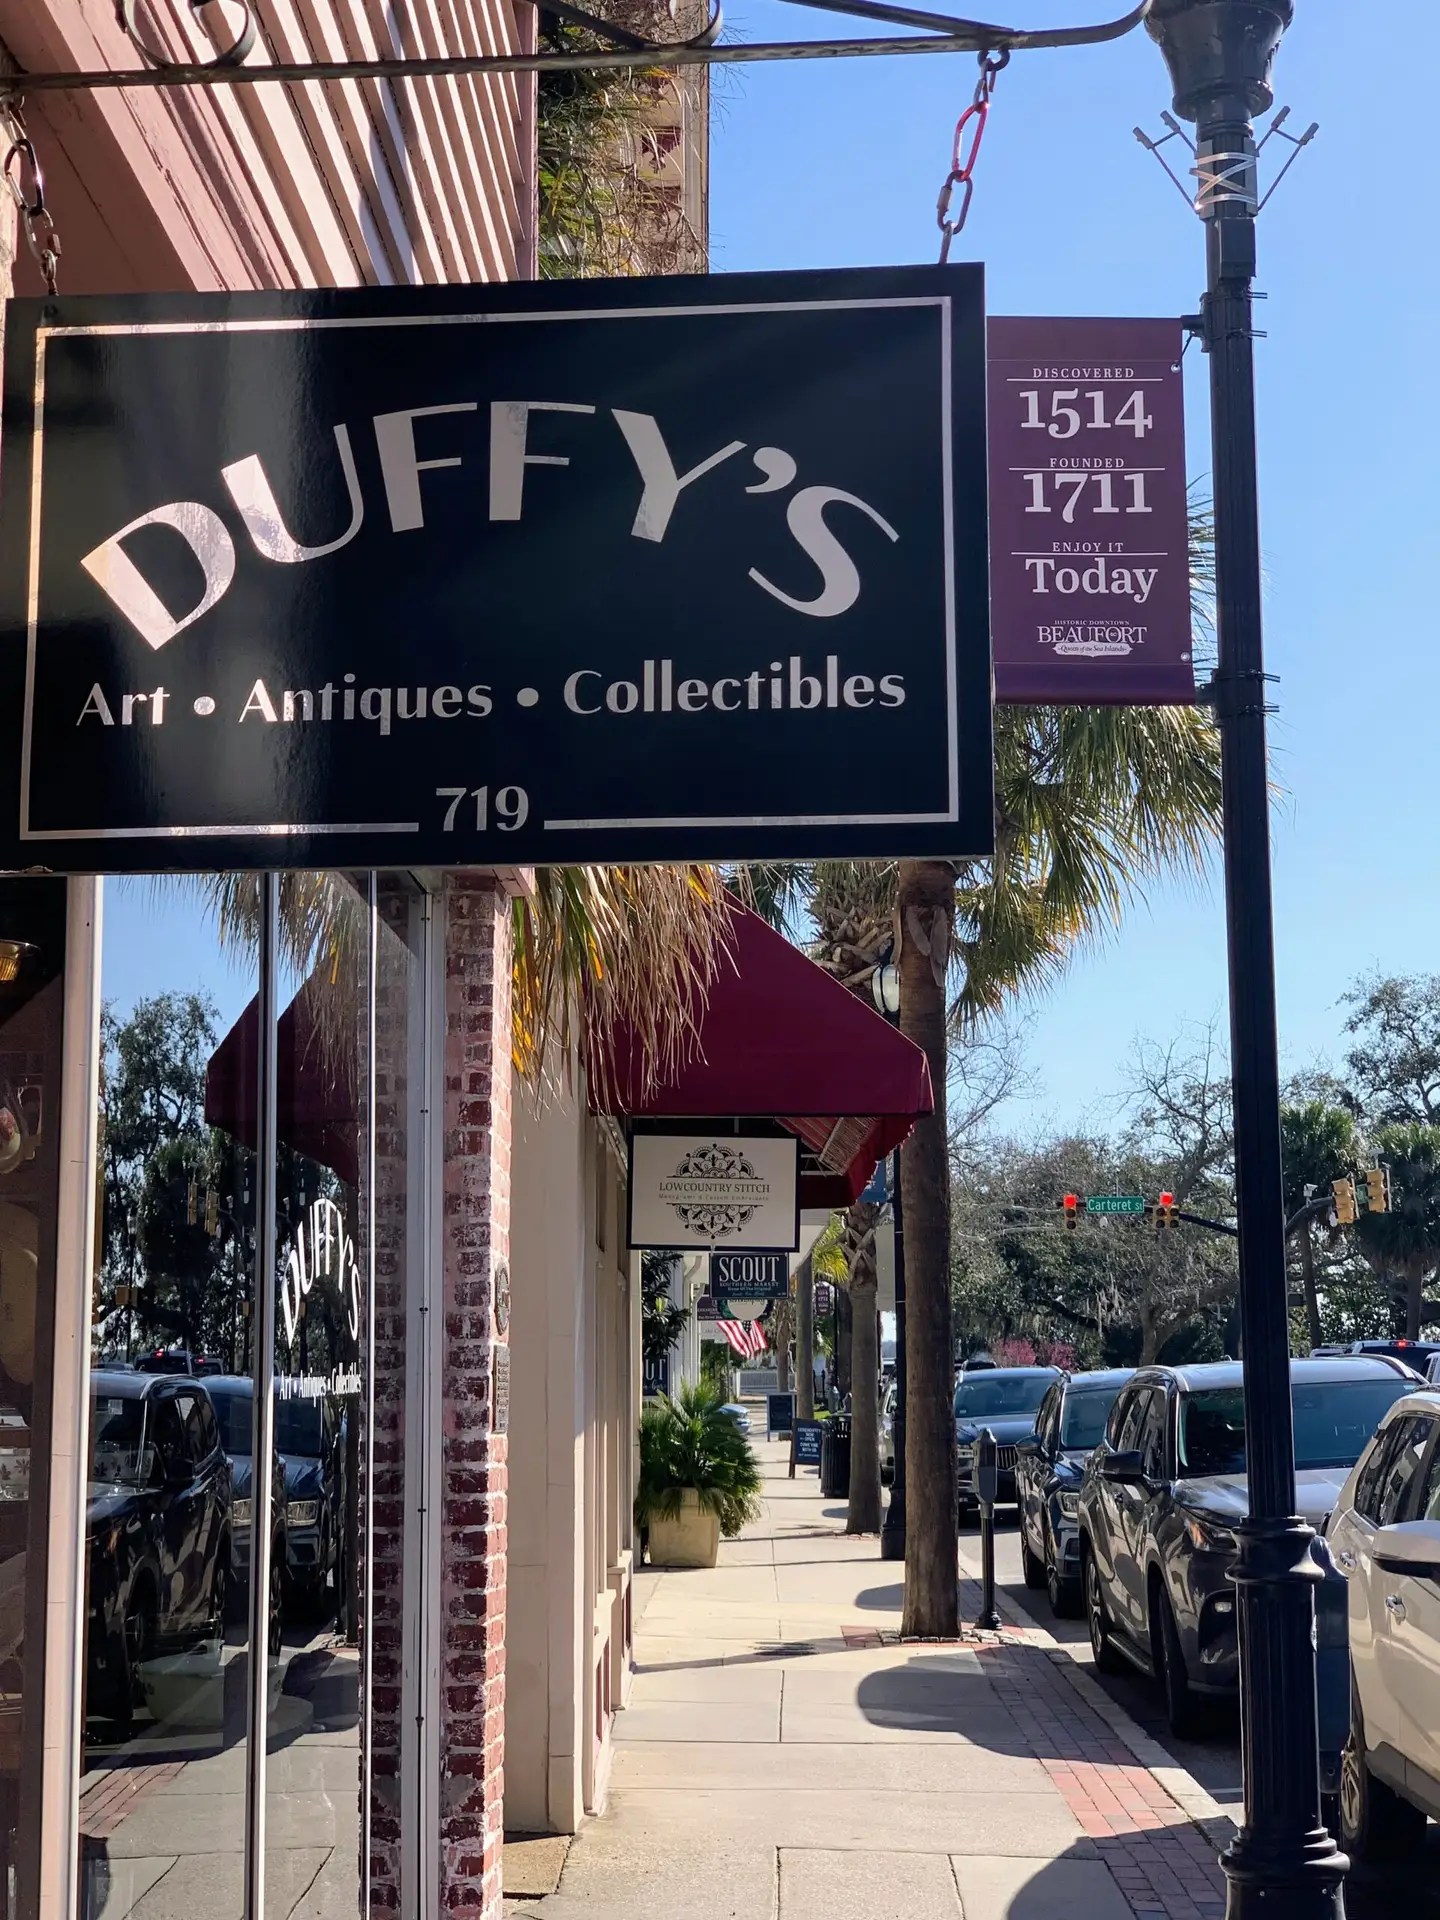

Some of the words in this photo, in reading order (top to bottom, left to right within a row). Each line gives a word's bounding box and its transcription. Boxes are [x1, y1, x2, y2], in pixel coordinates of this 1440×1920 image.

[1032, 367, 1135, 379] DISCOVERED
[1019, 388, 1153, 439] 1514
[1049, 457, 1125, 468] FOUNDED
[1022, 473, 1153, 524] 1711
[80, 401, 899, 650] DUFFY'S
[1052, 541, 1101, 553] ENJOY
[1107, 541, 1124, 552] IT
[1025, 557, 1158, 604] Today
[1037, 625, 1148, 644] BEAUFORT
[76, 682, 171, 726] Art
[238, 672, 493, 736] Antiques
[563, 654, 907, 718] Collectibles
[434, 785, 530, 834] 719
[659, 1181, 732, 1193] LOWCOUNTRY
[734, 1183, 770, 1193] STITCH
[1088, 1198, 1132, 1211] Carteret
[281, 1198, 362, 1349] DUFFY'S
[719, 1256, 780, 1282] SCOUT
[279, 1369, 292, 1401] Art
[298, 1366, 327, 1408] Antiques
[331, 1362, 362, 1396] Collectibles
